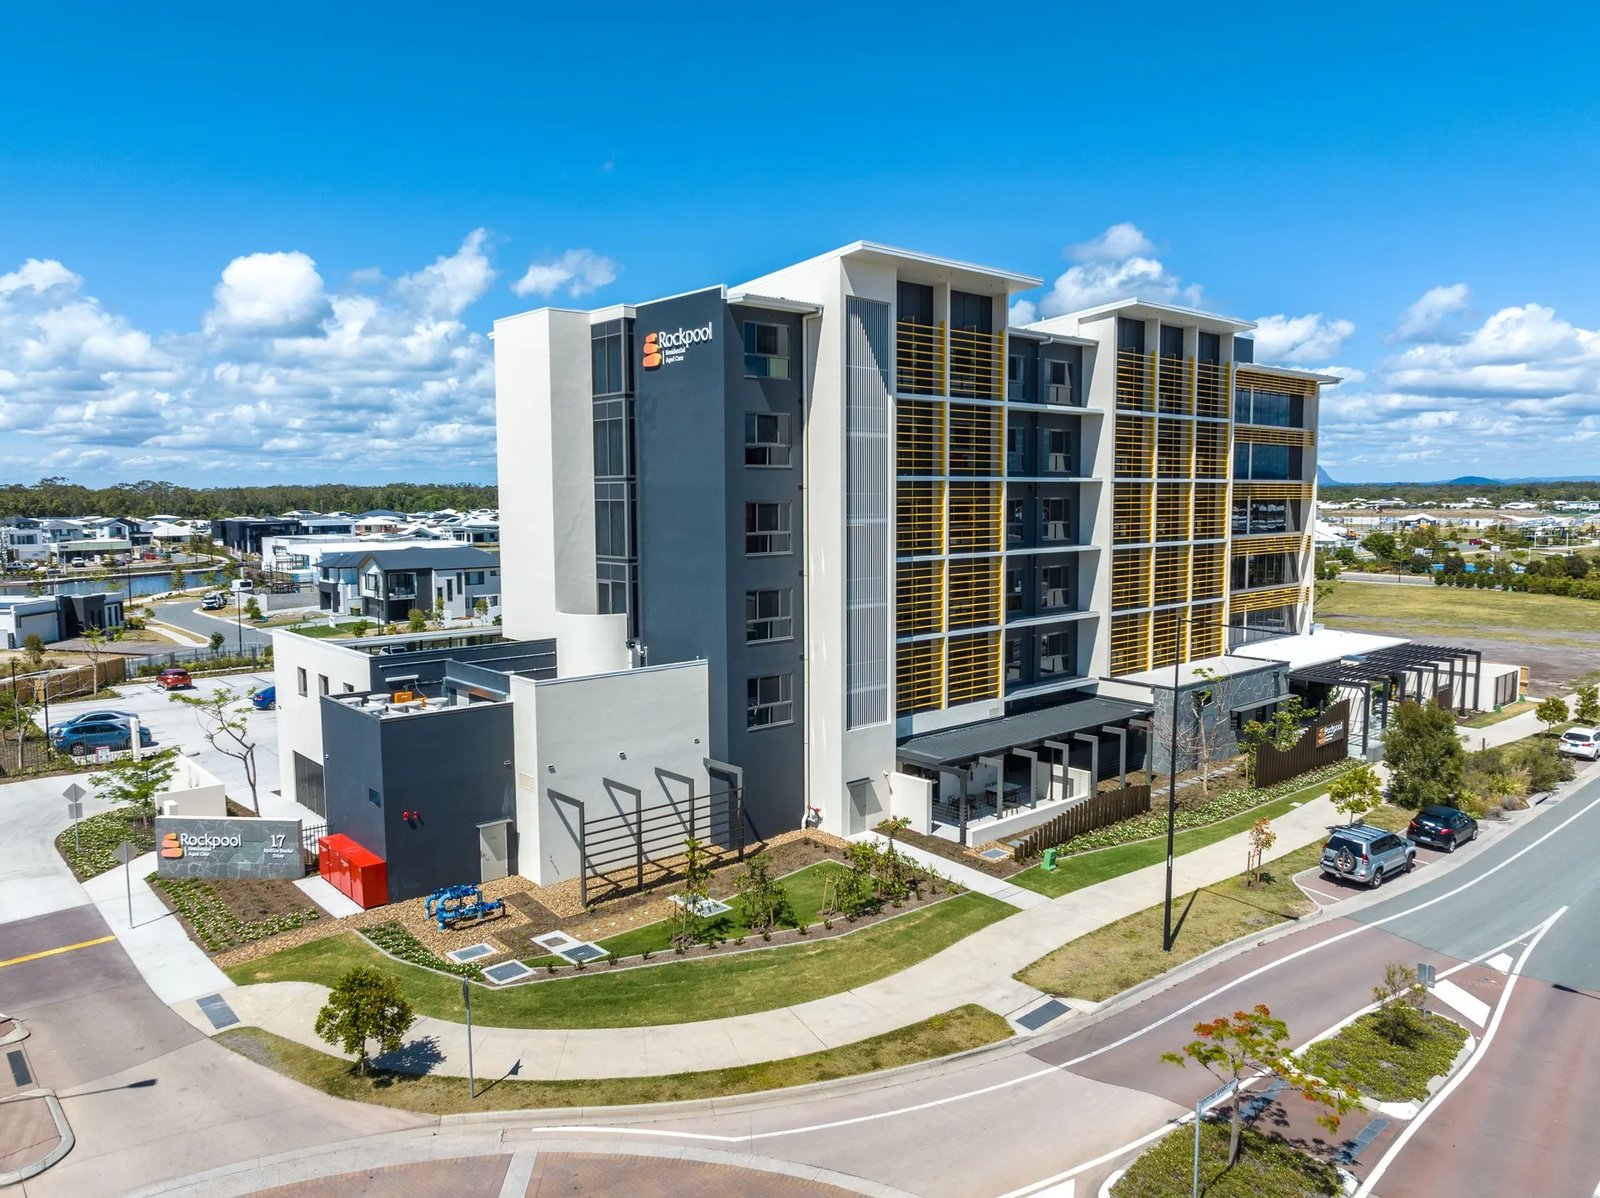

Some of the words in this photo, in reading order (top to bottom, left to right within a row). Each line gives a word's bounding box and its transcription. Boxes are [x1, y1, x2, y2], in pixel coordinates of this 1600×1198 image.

[659, 321, 712, 348] Rockpool
[180, 833, 241, 849] Rockpool
[270, 834, 286, 847] 17
